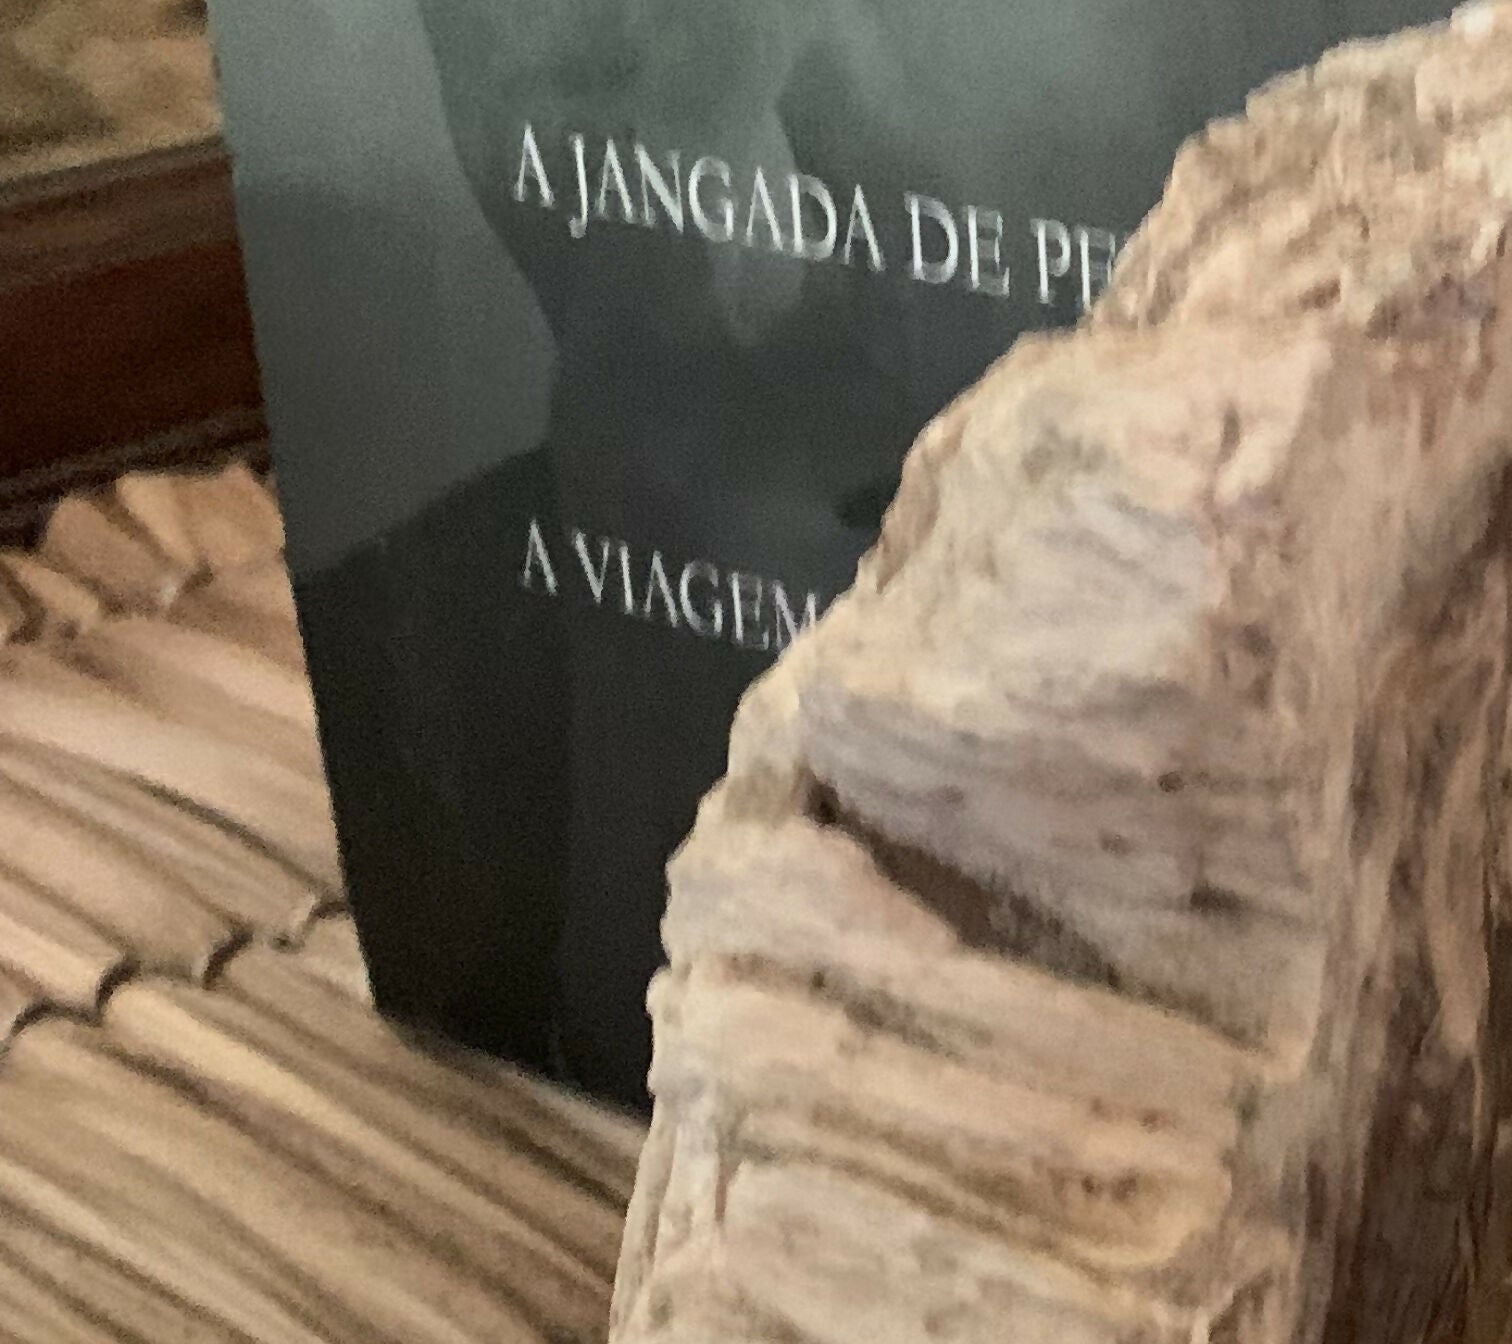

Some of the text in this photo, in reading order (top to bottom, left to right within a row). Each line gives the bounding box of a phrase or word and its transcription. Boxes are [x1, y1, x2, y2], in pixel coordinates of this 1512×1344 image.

[512, 121, 559, 210] A
[567, 132, 887, 276] JANGADA
[904, 192, 1010, 298] DE
[521, 517, 560, 597] A
